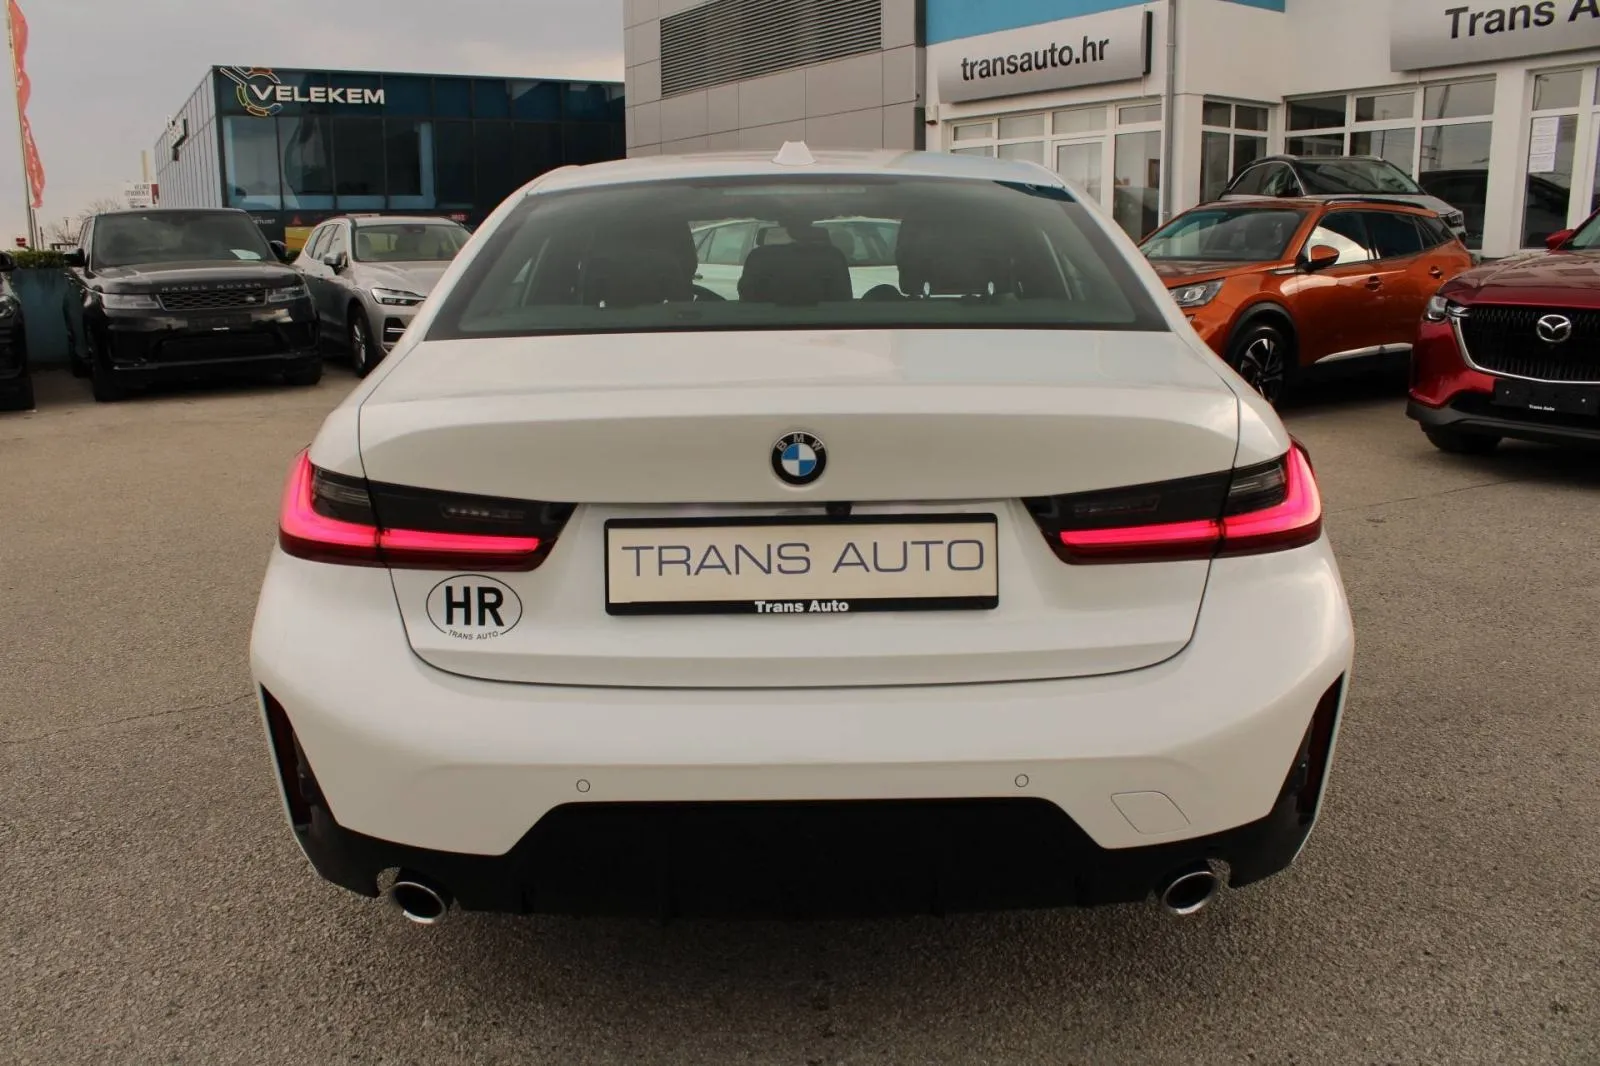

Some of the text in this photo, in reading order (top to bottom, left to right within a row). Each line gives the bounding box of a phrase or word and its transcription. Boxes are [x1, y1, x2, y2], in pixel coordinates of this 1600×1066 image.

[1444, 1, 1555, 39] Trans
[961, 35, 1110, 81] transauto.hr
[250, 84, 386, 105] VELEKEM
[776, 433, 823, 452] BMW
[621, 539, 984, 577] TRANS AUTO
[445, 585, 505, 627] HR
[755, 600, 849, 613] Trans Auto
[448, 629, 499, 640] TRANS AUTO
